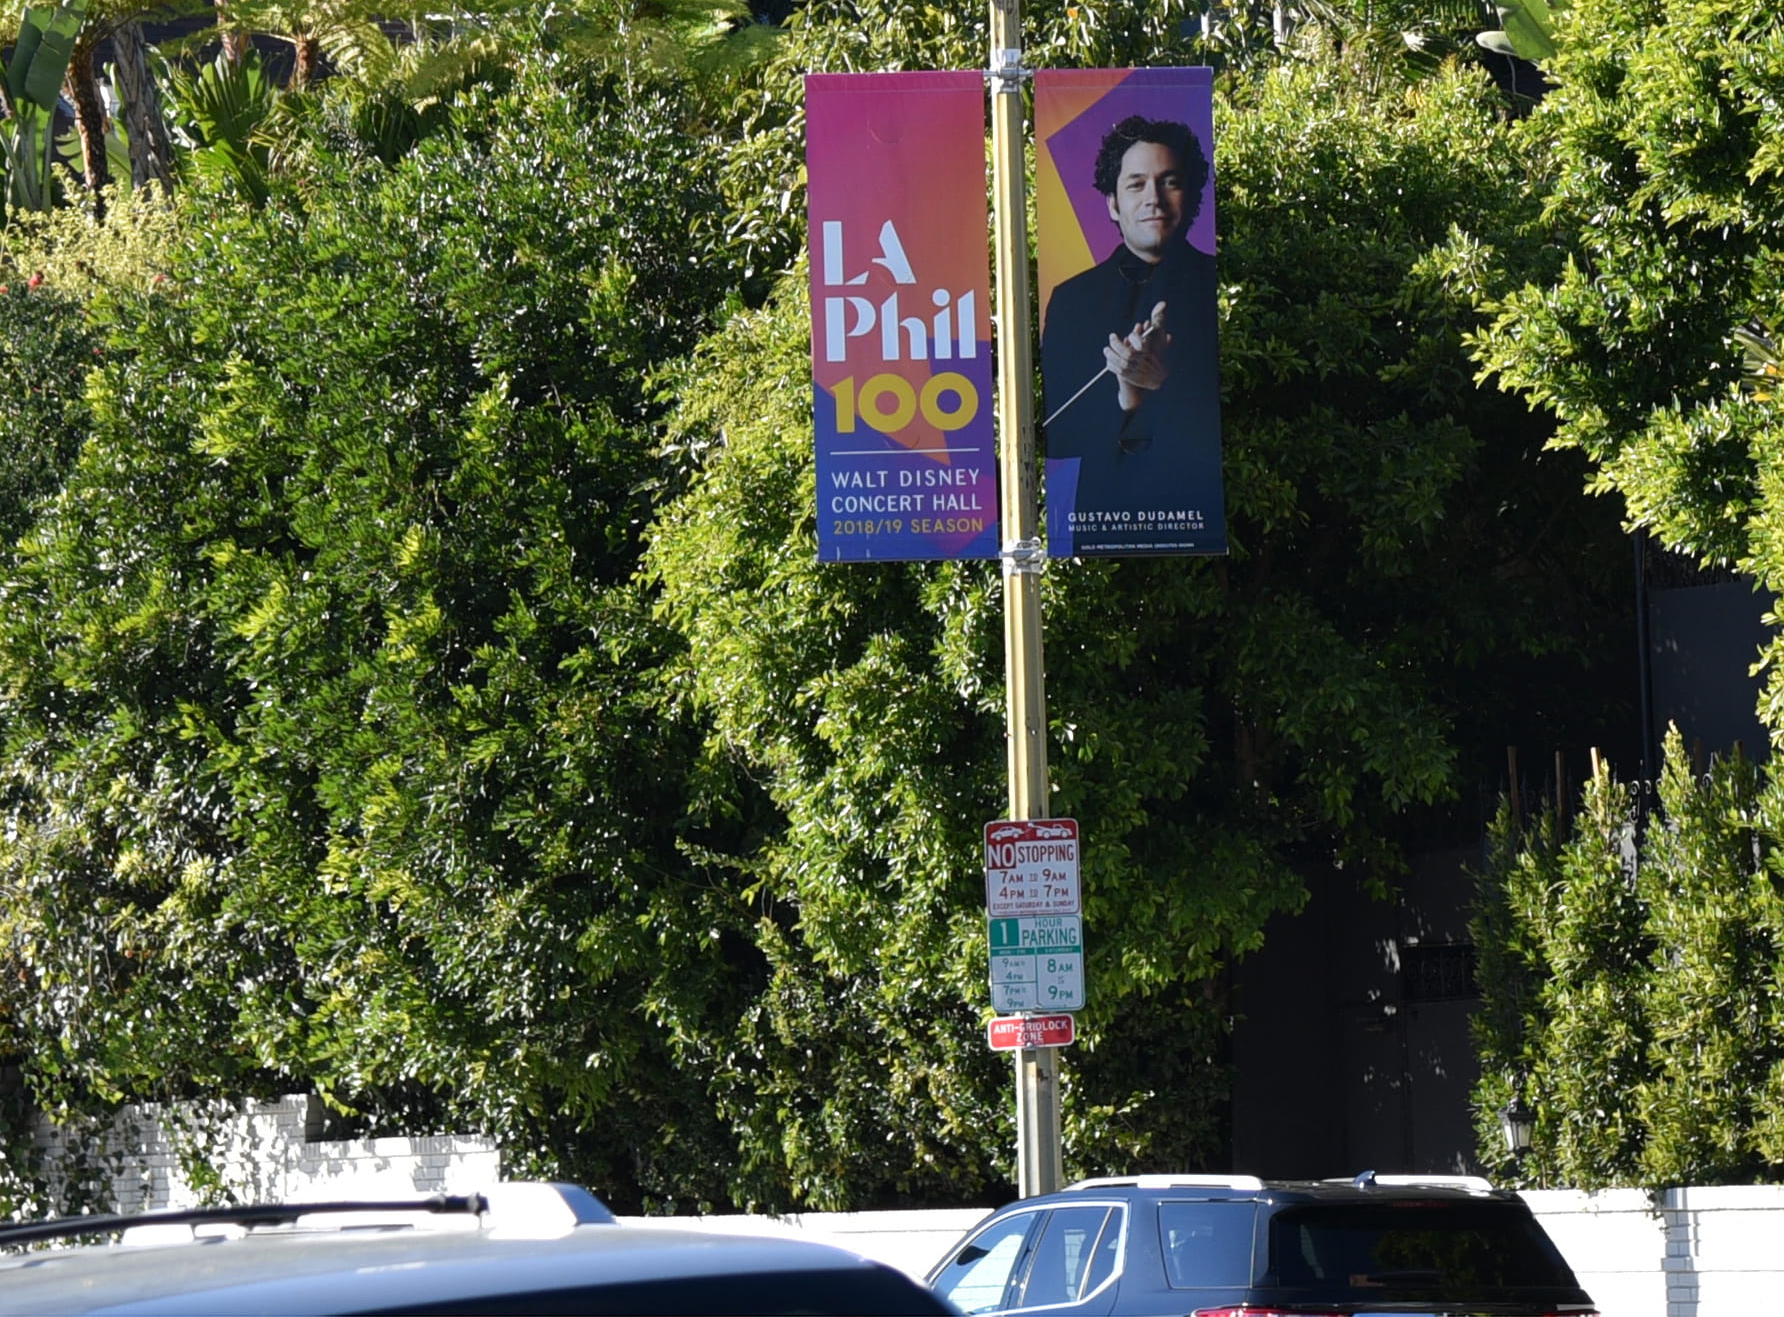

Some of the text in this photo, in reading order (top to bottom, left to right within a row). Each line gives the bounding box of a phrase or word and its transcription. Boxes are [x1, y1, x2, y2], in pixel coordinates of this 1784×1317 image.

[823, 219, 917, 286] LA
[824, 288, 977, 362] Phil
[830, 371, 979, 433] 100
[832, 468, 980, 489] WALT DISNEY
[831, 493, 982, 513] CONCERT HALL
[1068, 510, 1204, 522] GUSTAVO DUDAMEL
[833, 517, 983, 536] 2018/19 SEASON
[1068, 524, 1098, 532] MUSIC
[1111, 523, 1154, 531] ARTISTIC
[1158, 522, 1204, 530] DIRECTOR
[988, 843, 1074, 868] NO STOPPING
[1000, 918, 1063, 944] 1 HOUR
[1022, 927, 1076, 946] PARKING
[993, 1020, 1068, 1034] ANTI-GRIDLOCK
[1016, 1031, 1044, 1042] ZONE
